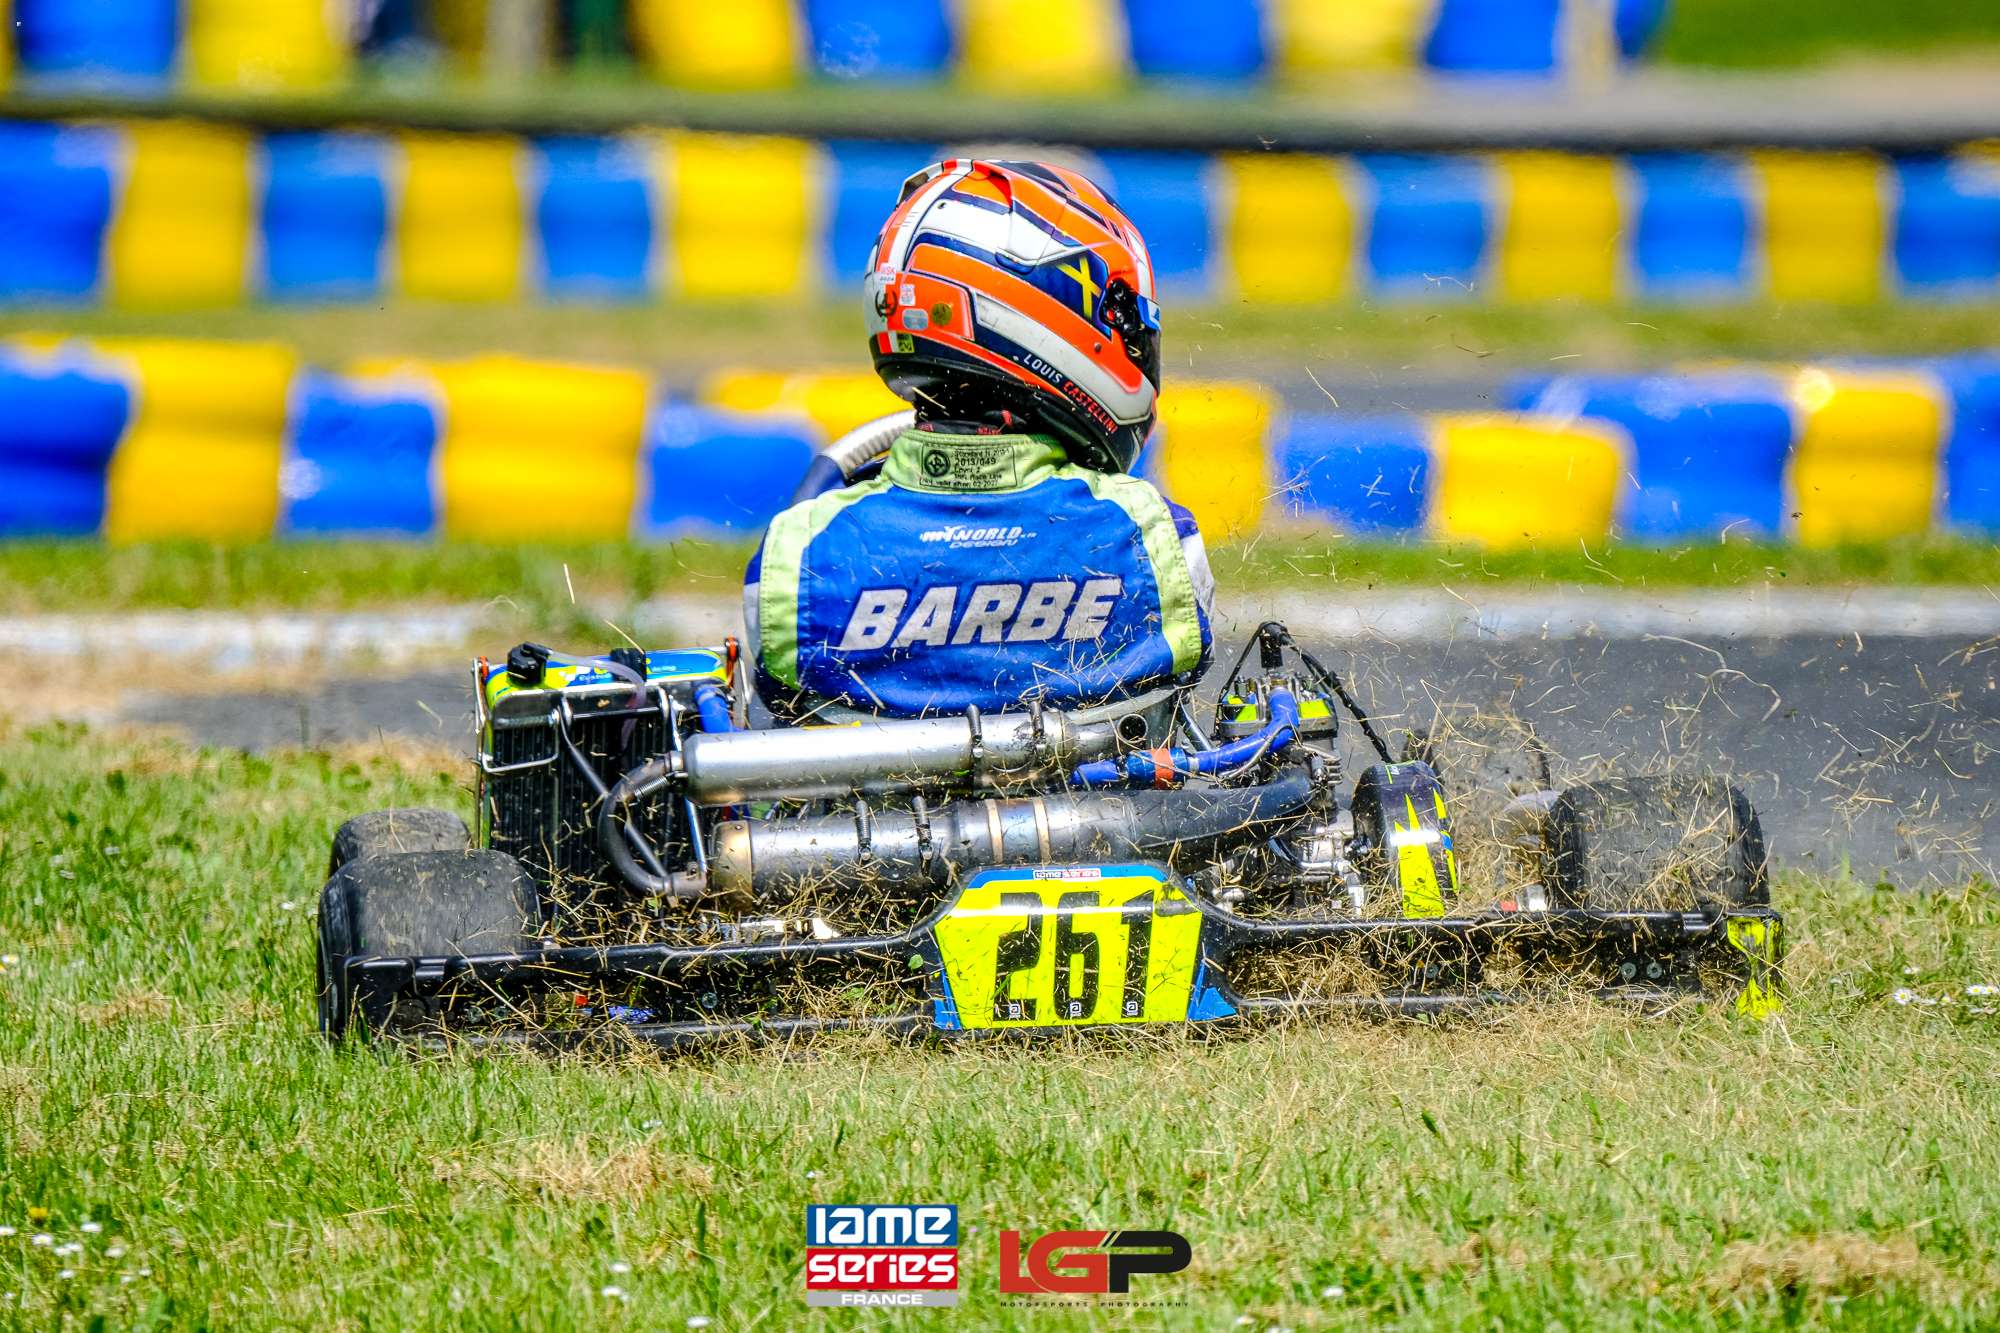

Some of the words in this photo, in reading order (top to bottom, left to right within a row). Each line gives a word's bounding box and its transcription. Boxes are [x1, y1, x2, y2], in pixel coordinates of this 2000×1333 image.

[1023, 353, 1064, 384] LOUIS
[1062, 380, 1118, 434] CASTELLINI
[840, 578, 1122, 651] BARBE
[993, 889, 1154, 1021] 261
